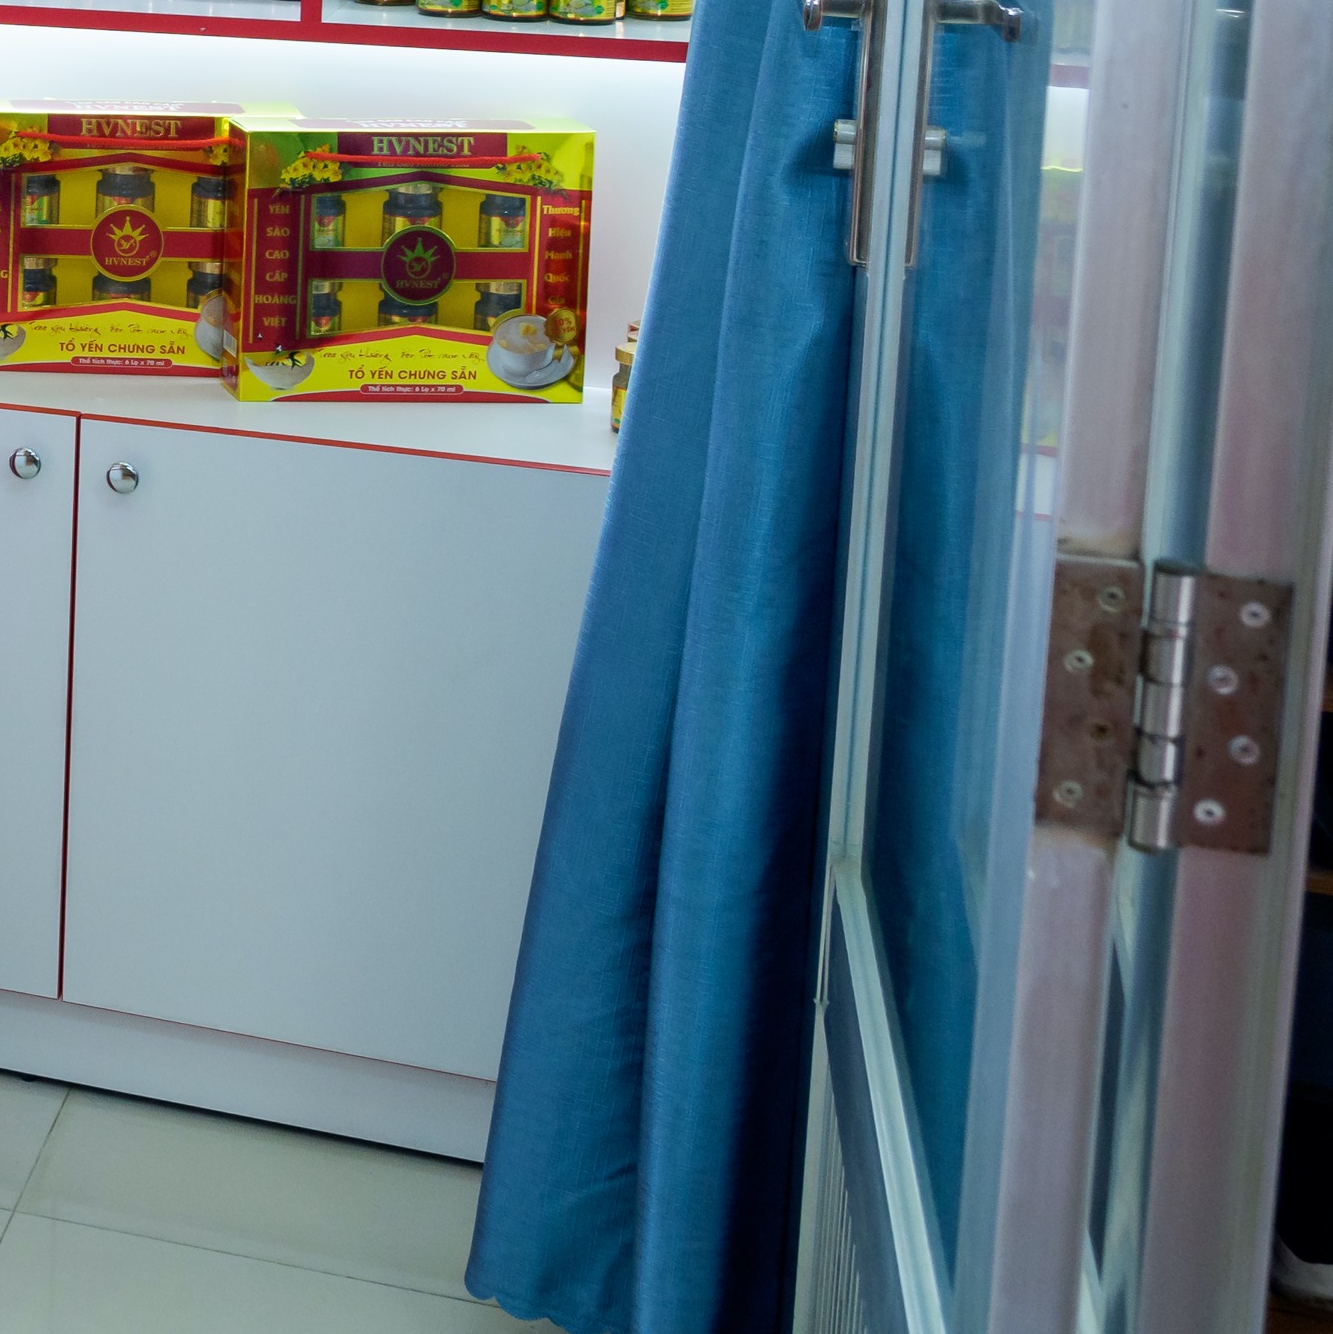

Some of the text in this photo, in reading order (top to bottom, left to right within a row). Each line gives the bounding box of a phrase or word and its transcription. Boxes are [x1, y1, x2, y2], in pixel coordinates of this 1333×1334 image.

[81, 117, 182, 138] HVNEST
[372, 136, 475, 156] HVNEST
[105, 257, 147, 266] HVNEST
[80, 339, 103, 353] YẾN
[108, 342, 155, 355] CHƯNG
[370, 363, 394, 380] YẾN
[398, 369, 447, 381] CHƯNG
